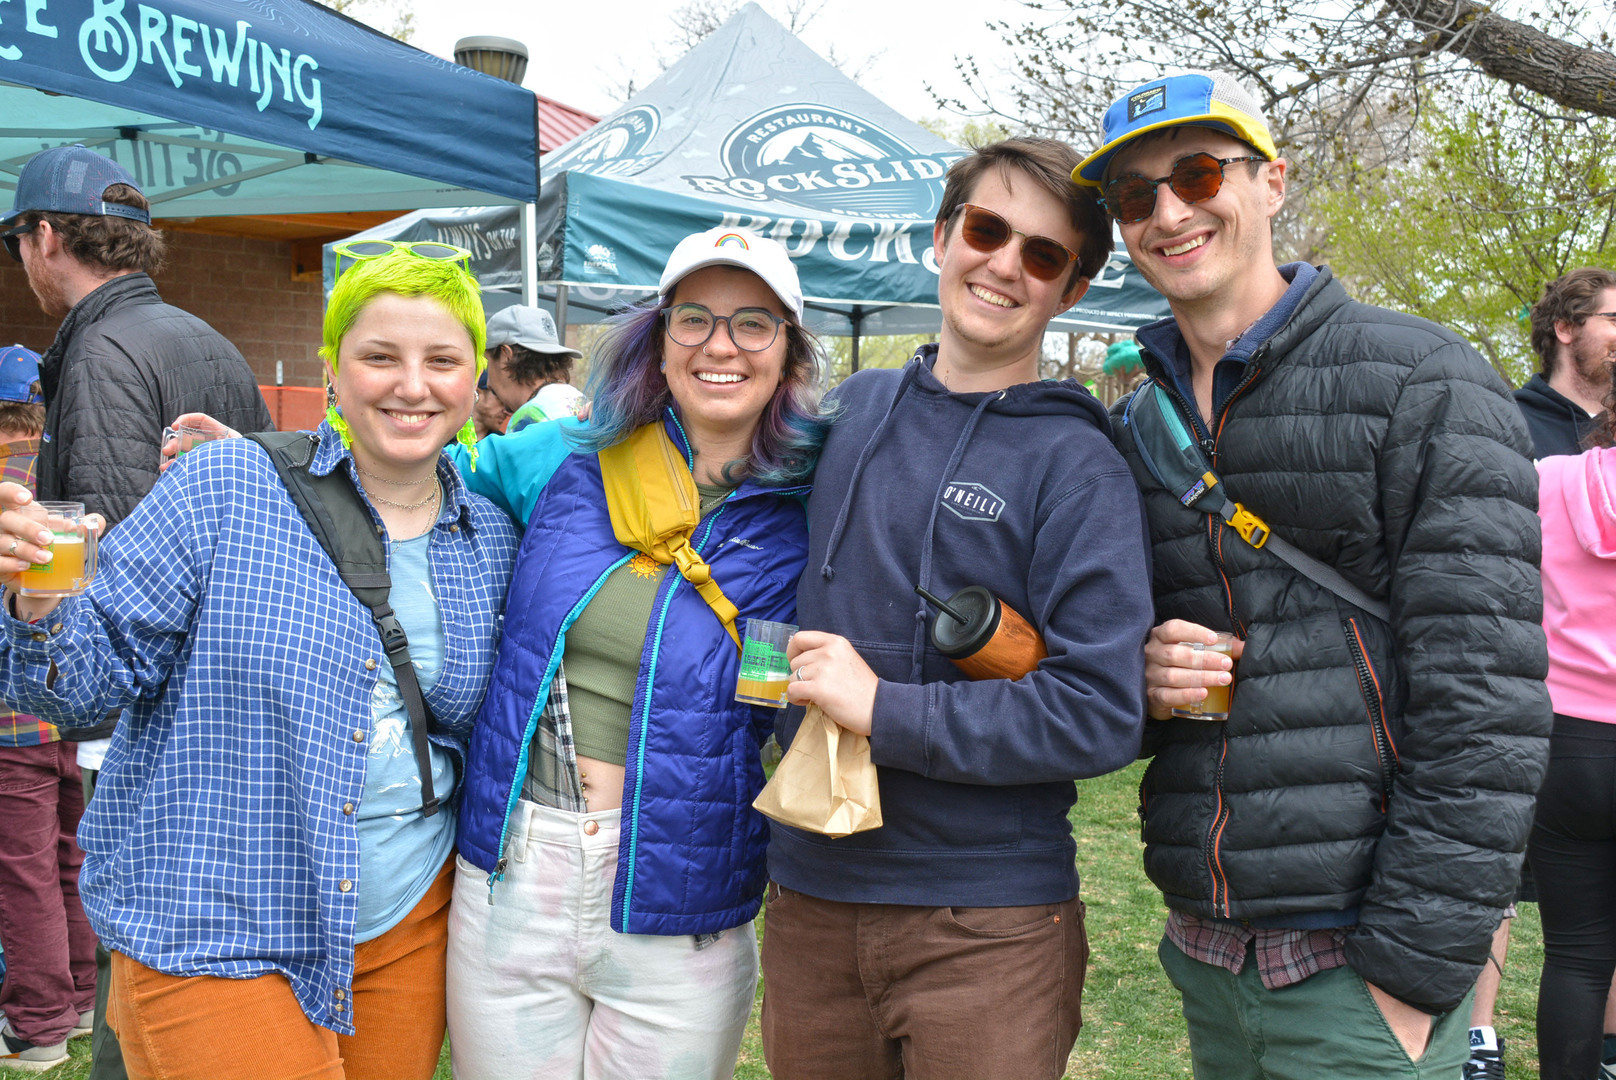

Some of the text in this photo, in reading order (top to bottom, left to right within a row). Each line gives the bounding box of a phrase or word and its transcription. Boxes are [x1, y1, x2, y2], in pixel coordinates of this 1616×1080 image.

[78, 0, 322, 131] BREWING
[746, 113, 867, 144] RESTAURANT
[486, 231, 504, 251] ON
[500, 227, 516, 249] TAP
[943, 485, 997, 516] O'NEILL
